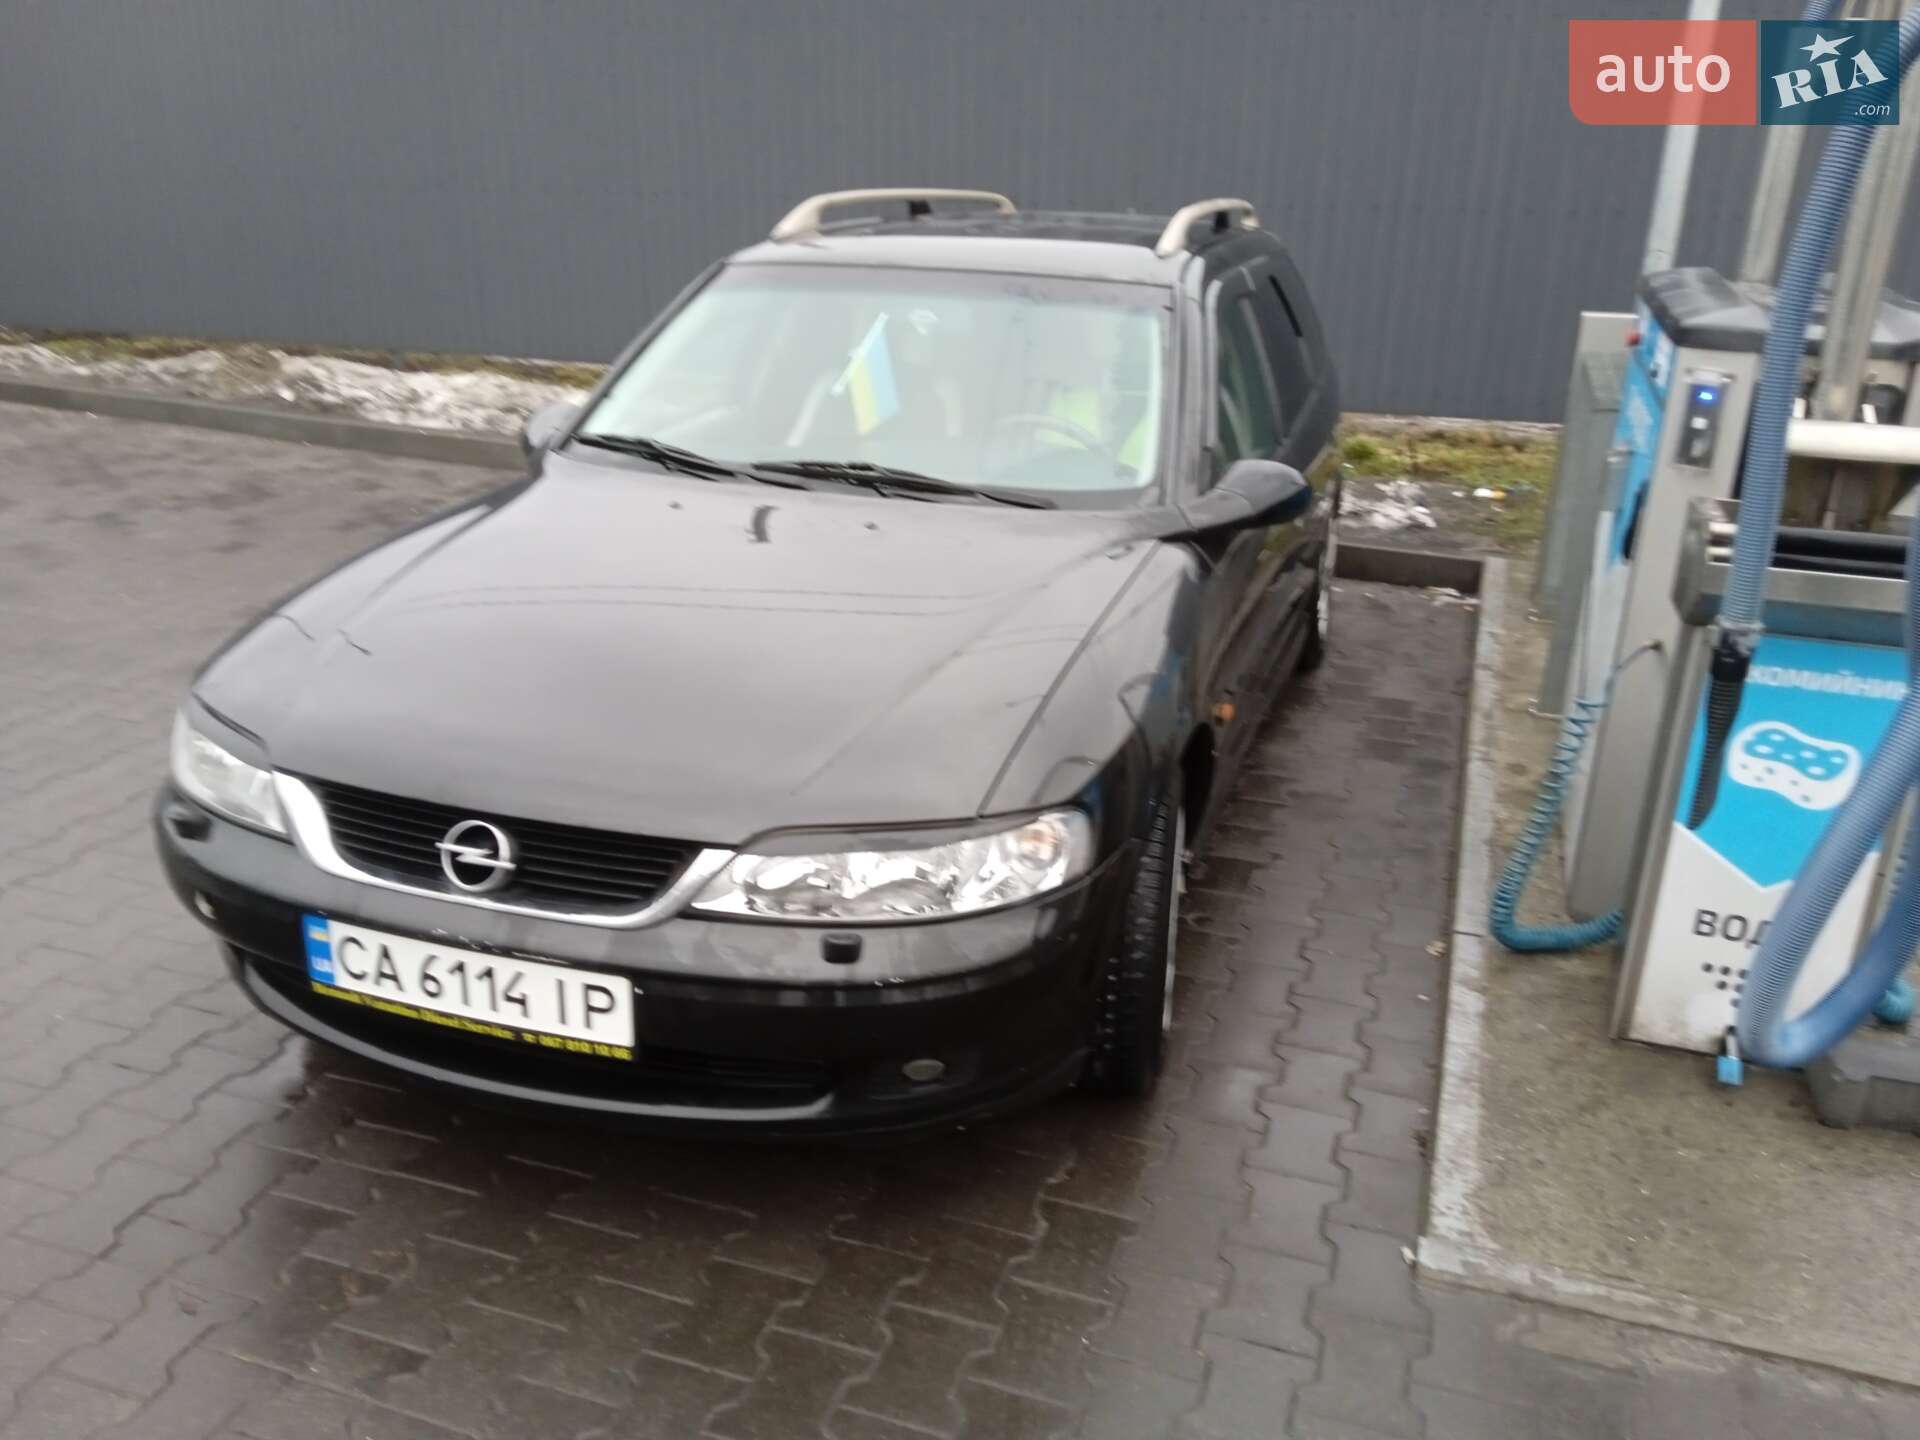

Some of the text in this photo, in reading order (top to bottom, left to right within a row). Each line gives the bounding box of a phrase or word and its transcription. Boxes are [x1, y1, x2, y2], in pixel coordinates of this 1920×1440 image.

[1693, 908, 1772, 949] ВОД
[336, 936, 404, 993] CA
[419, 954, 530, 1018] 6114
[555, 978, 616, 1030] IP
